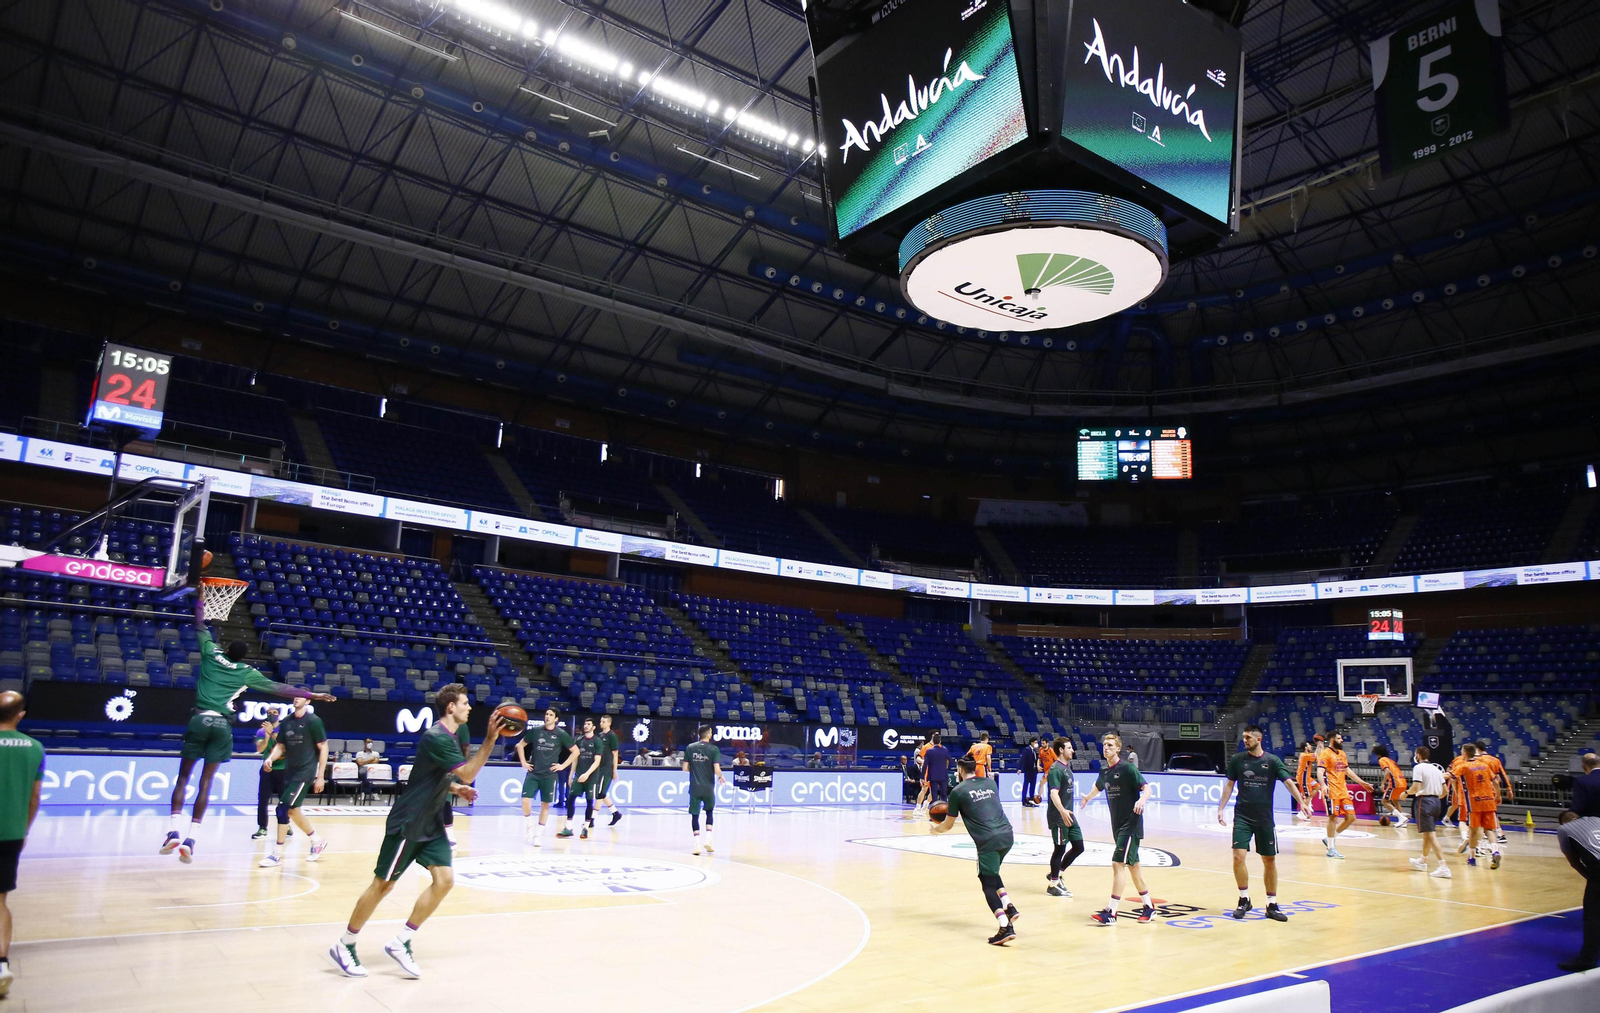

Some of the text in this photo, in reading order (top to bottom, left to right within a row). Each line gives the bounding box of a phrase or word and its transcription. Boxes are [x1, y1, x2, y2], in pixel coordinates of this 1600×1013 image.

[1407, 16, 1457, 51] BERNI
[1083, 17, 1212, 142] Andalucía
[1416, 45, 1459, 112] 5
[839, 47, 986, 164] Andalucía
[1412, 144, 1437, 160] 1999
[1449, 130, 1474, 147] 2012
[953, 281, 1049, 320] Unicaja
[111, 350, 170, 375] 15:05
[104, 373, 157, 410] 24
[65, 559, 153, 586] endesa
[1370, 610, 1392, 618] 15:05
[1371, 620, 1390, 633] 24
[124, 688, 137, 698] bp
[0, 737, 33, 748] oma
[658, 780, 770, 804] enesa
[791, 776, 886, 802] endesa
[458, 866, 674, 879] PEDRIZAS
